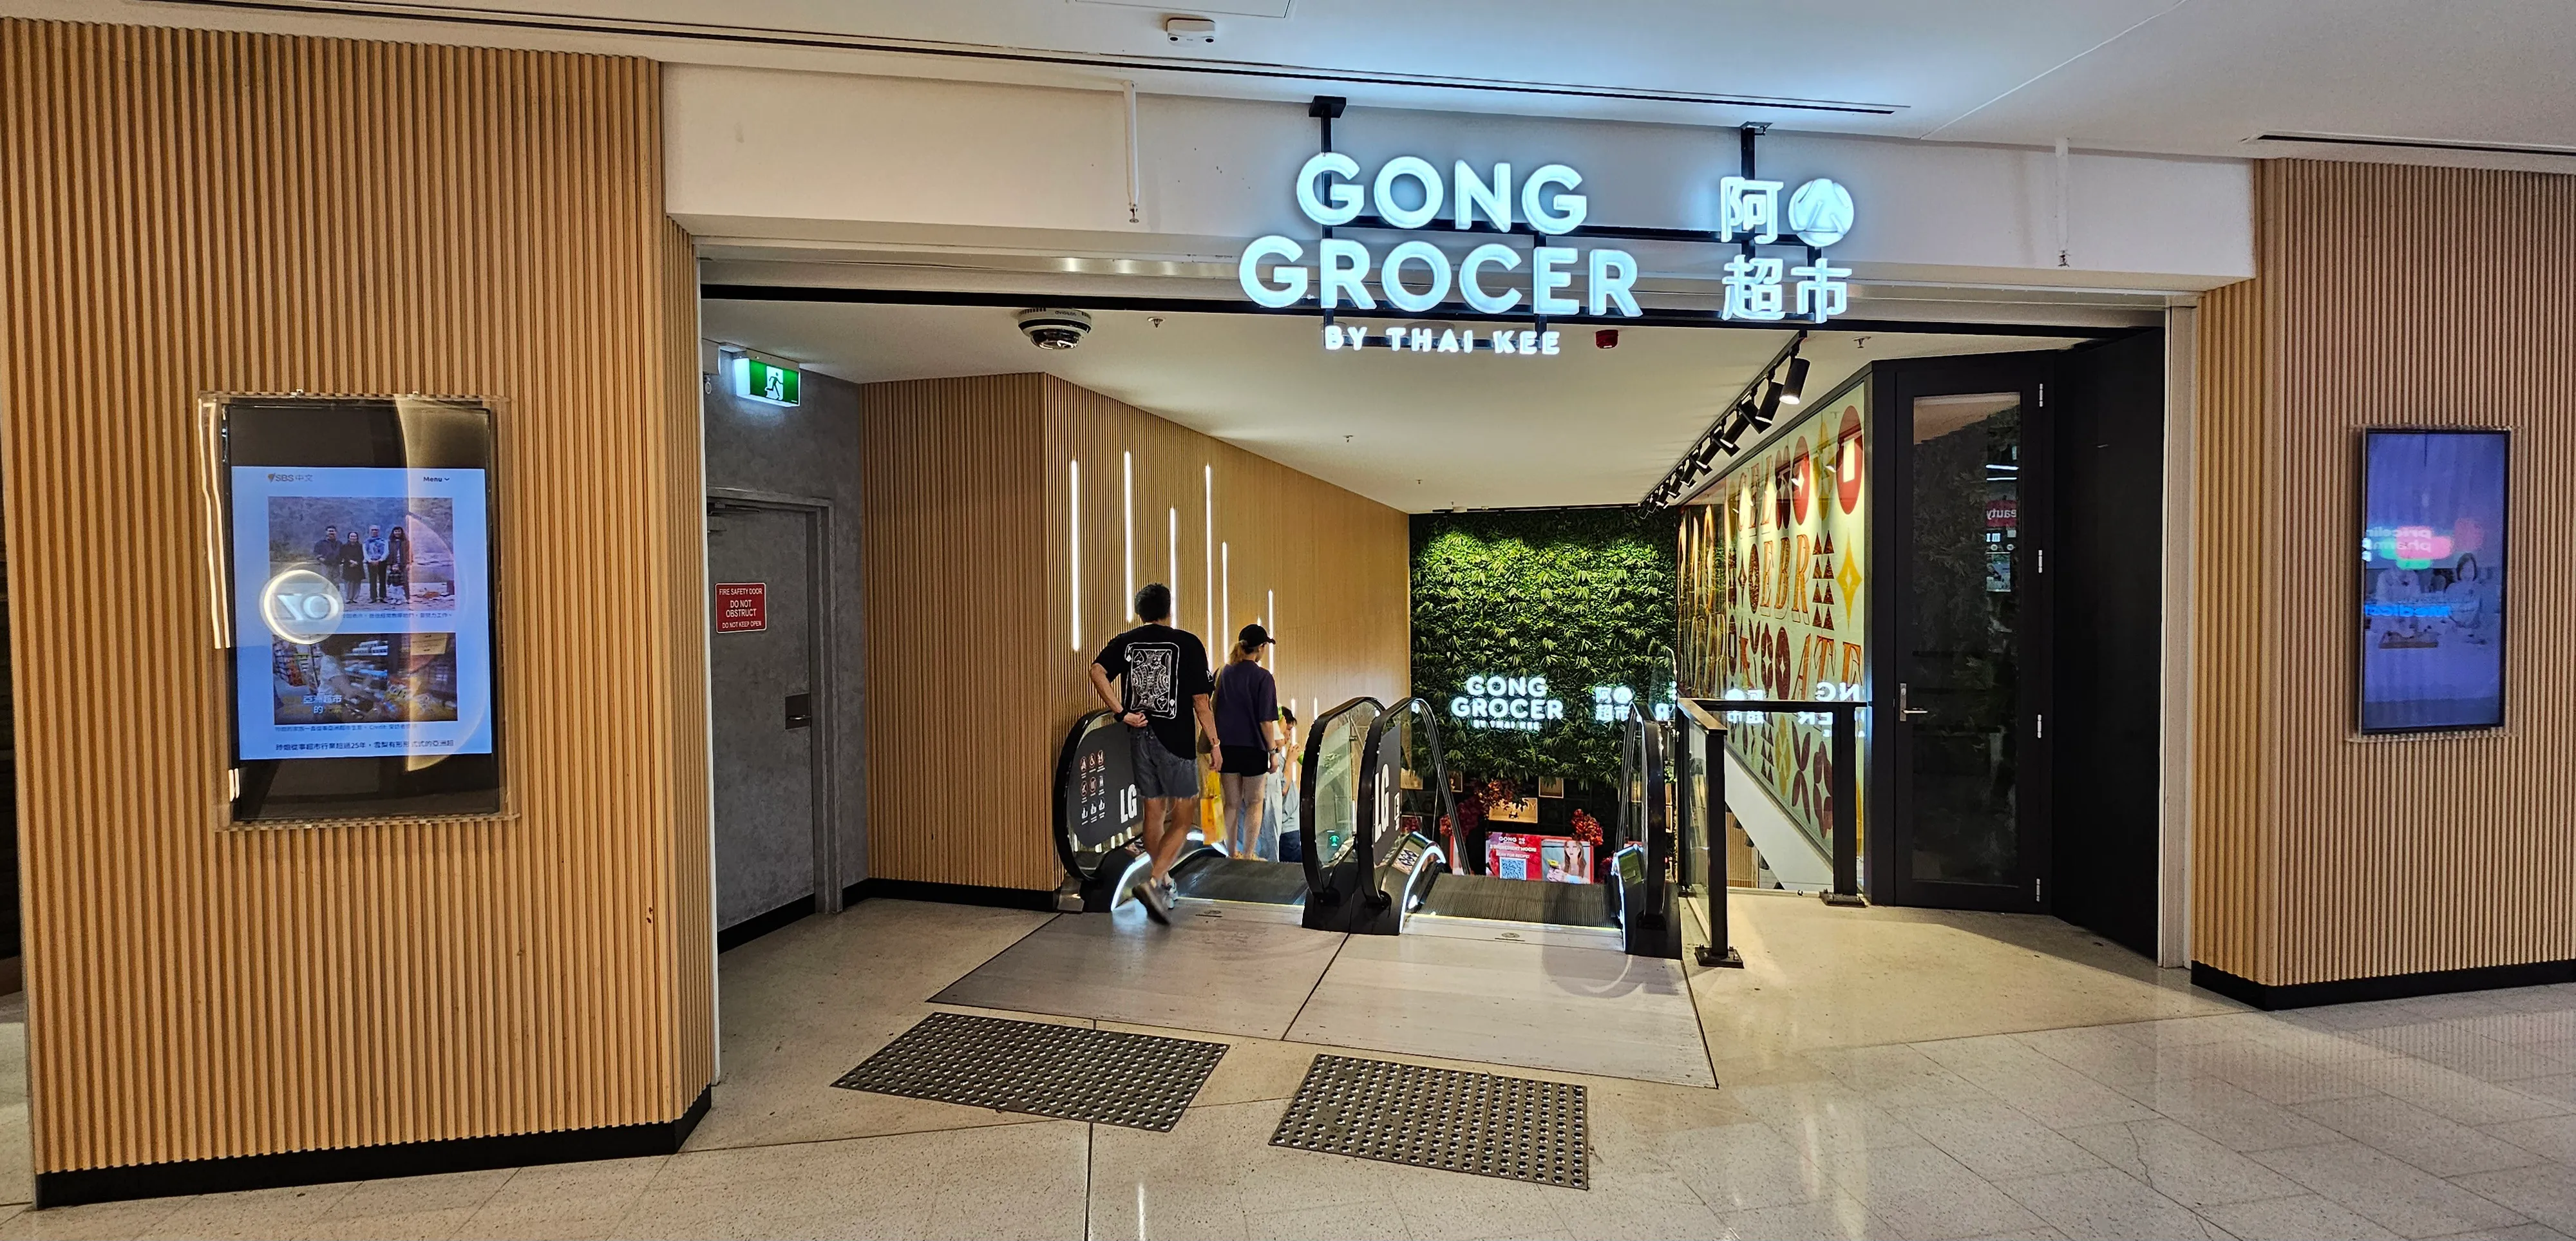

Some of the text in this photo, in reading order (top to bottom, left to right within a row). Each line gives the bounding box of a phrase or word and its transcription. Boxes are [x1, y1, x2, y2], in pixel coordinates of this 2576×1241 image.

[1296, 152, 1587, 235] GONG
[1238, 235, 1643, 317] GROCER
[1721, 254, 1852, 323] 超市
[1324, 325, 1560, 355] BY THAI KEE
[726, 608, 757, 618] OBSTRUCT
[730, 599, 752, 608] DO NOT
[1466, 676, 1549, 697] GONG
[1170, 708, 1175, 716] K
[1451, 697, 1564, 720] GROCER
[1121, 784, 1137, 824] LG
[1375, 764, 1390, 843] LG
